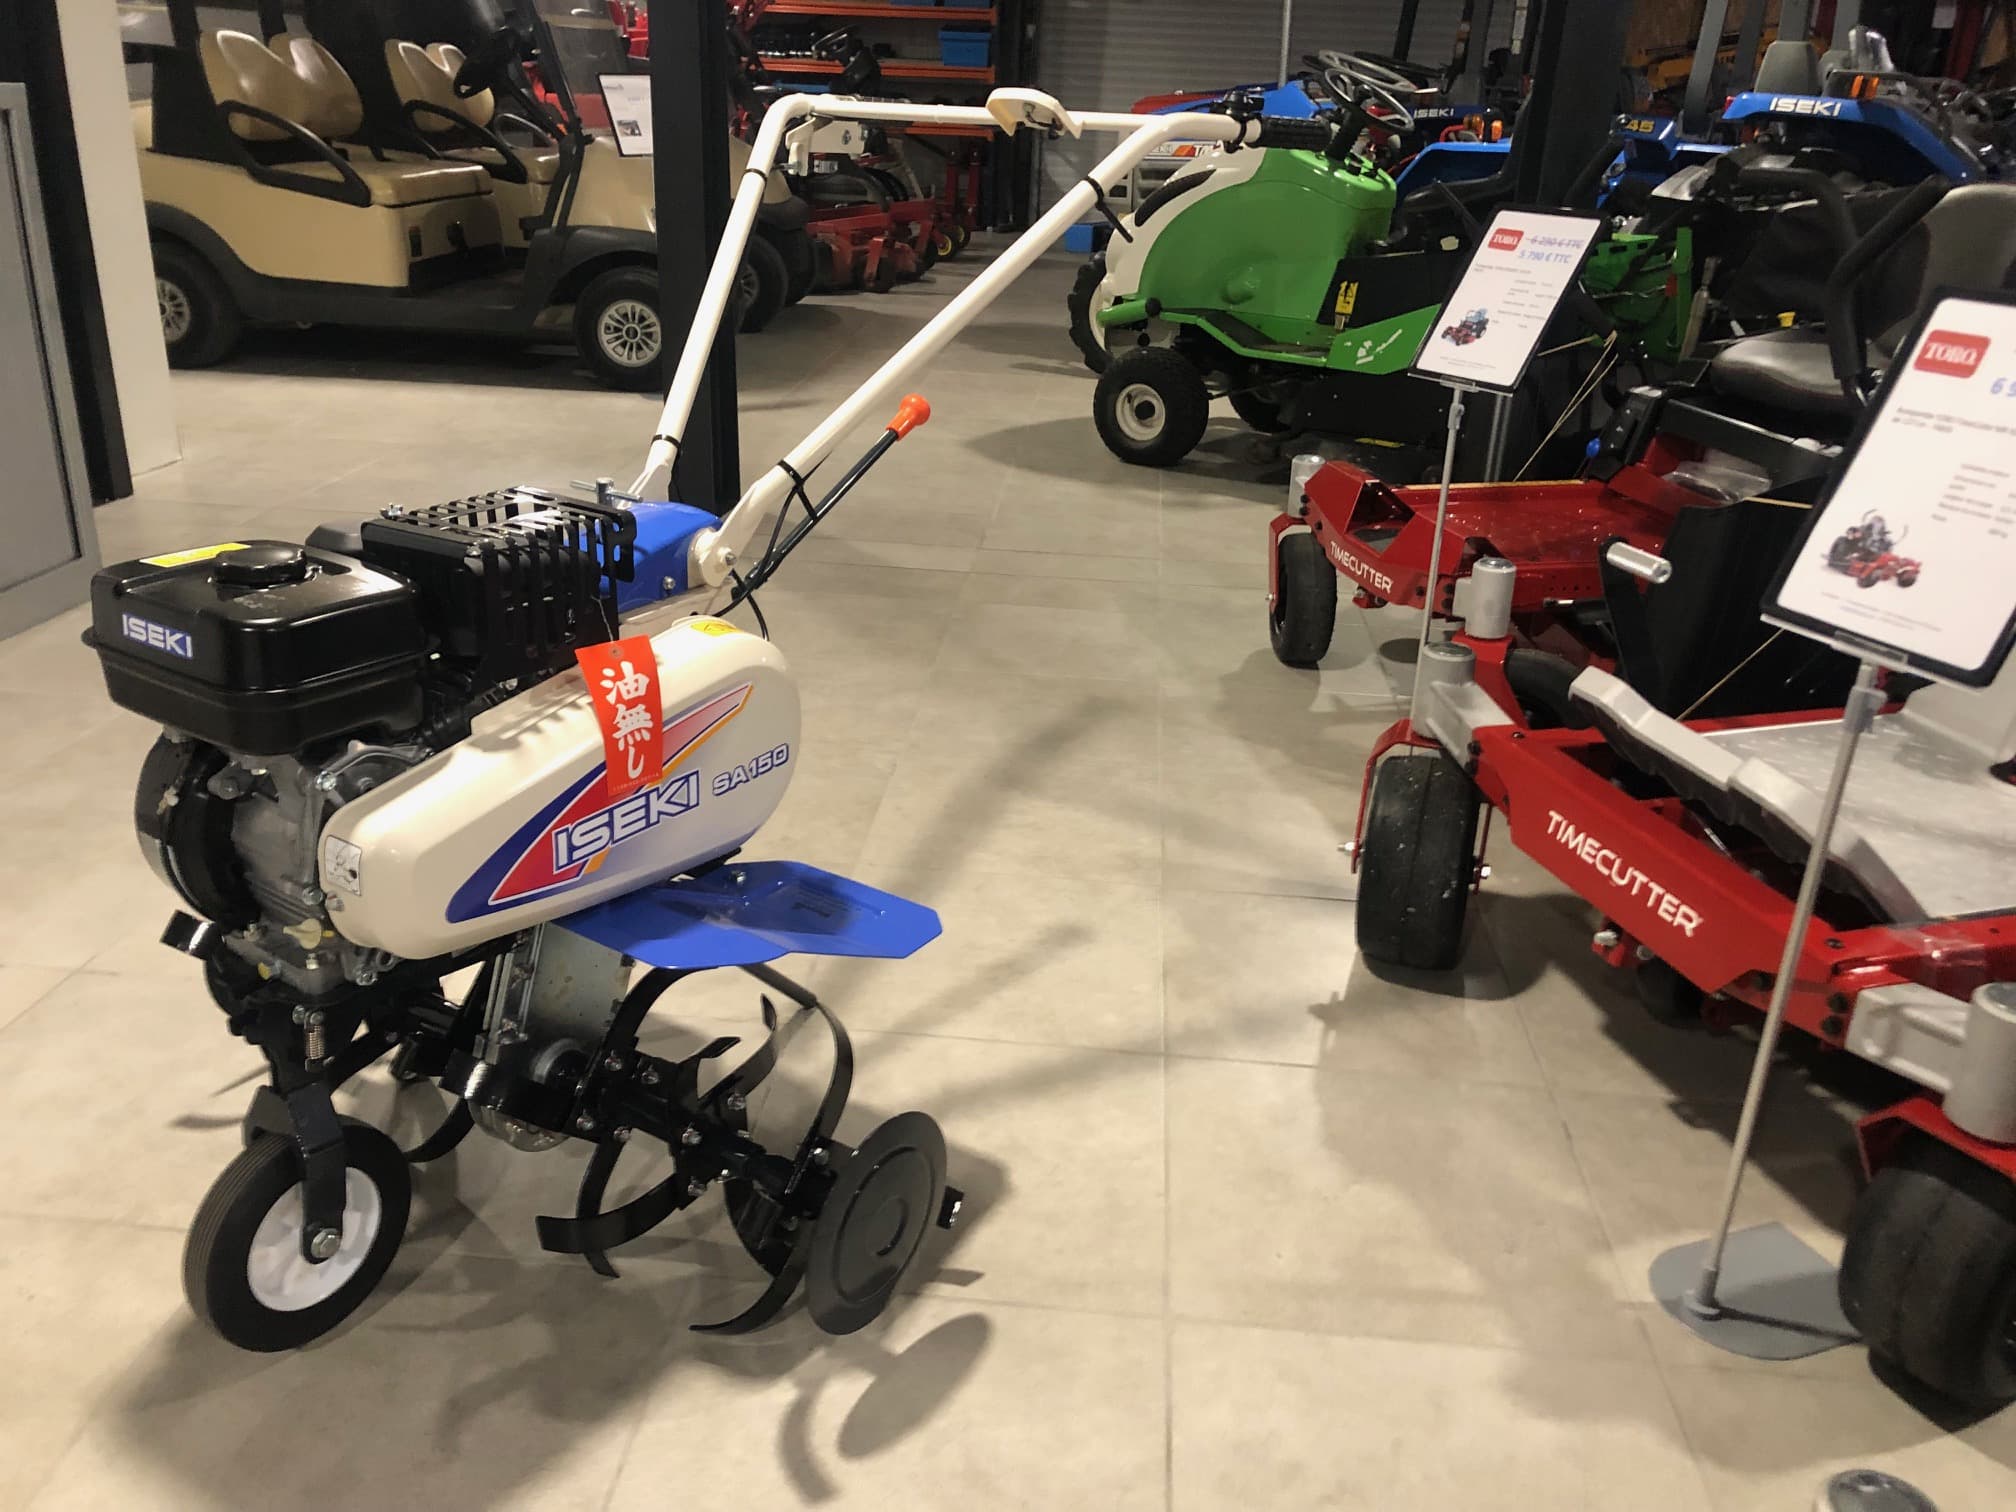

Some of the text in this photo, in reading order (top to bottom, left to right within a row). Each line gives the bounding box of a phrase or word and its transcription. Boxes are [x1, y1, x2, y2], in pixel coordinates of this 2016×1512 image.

[1413, 107, 1455, 119] ISEKI
[1770, 96, 1843, 117] ISEKI
[1924, 342, 1978, 366] TORO
[1330, 540, 1394, 594] TIMECUTTER
[122, 613, 193, 658] ISEKI
[600, 660, 653, 779] 油無し
[554, 743, 790, 872] ISEKI SA150
[1547, 810, 1704, 938] TIMECUTTER
